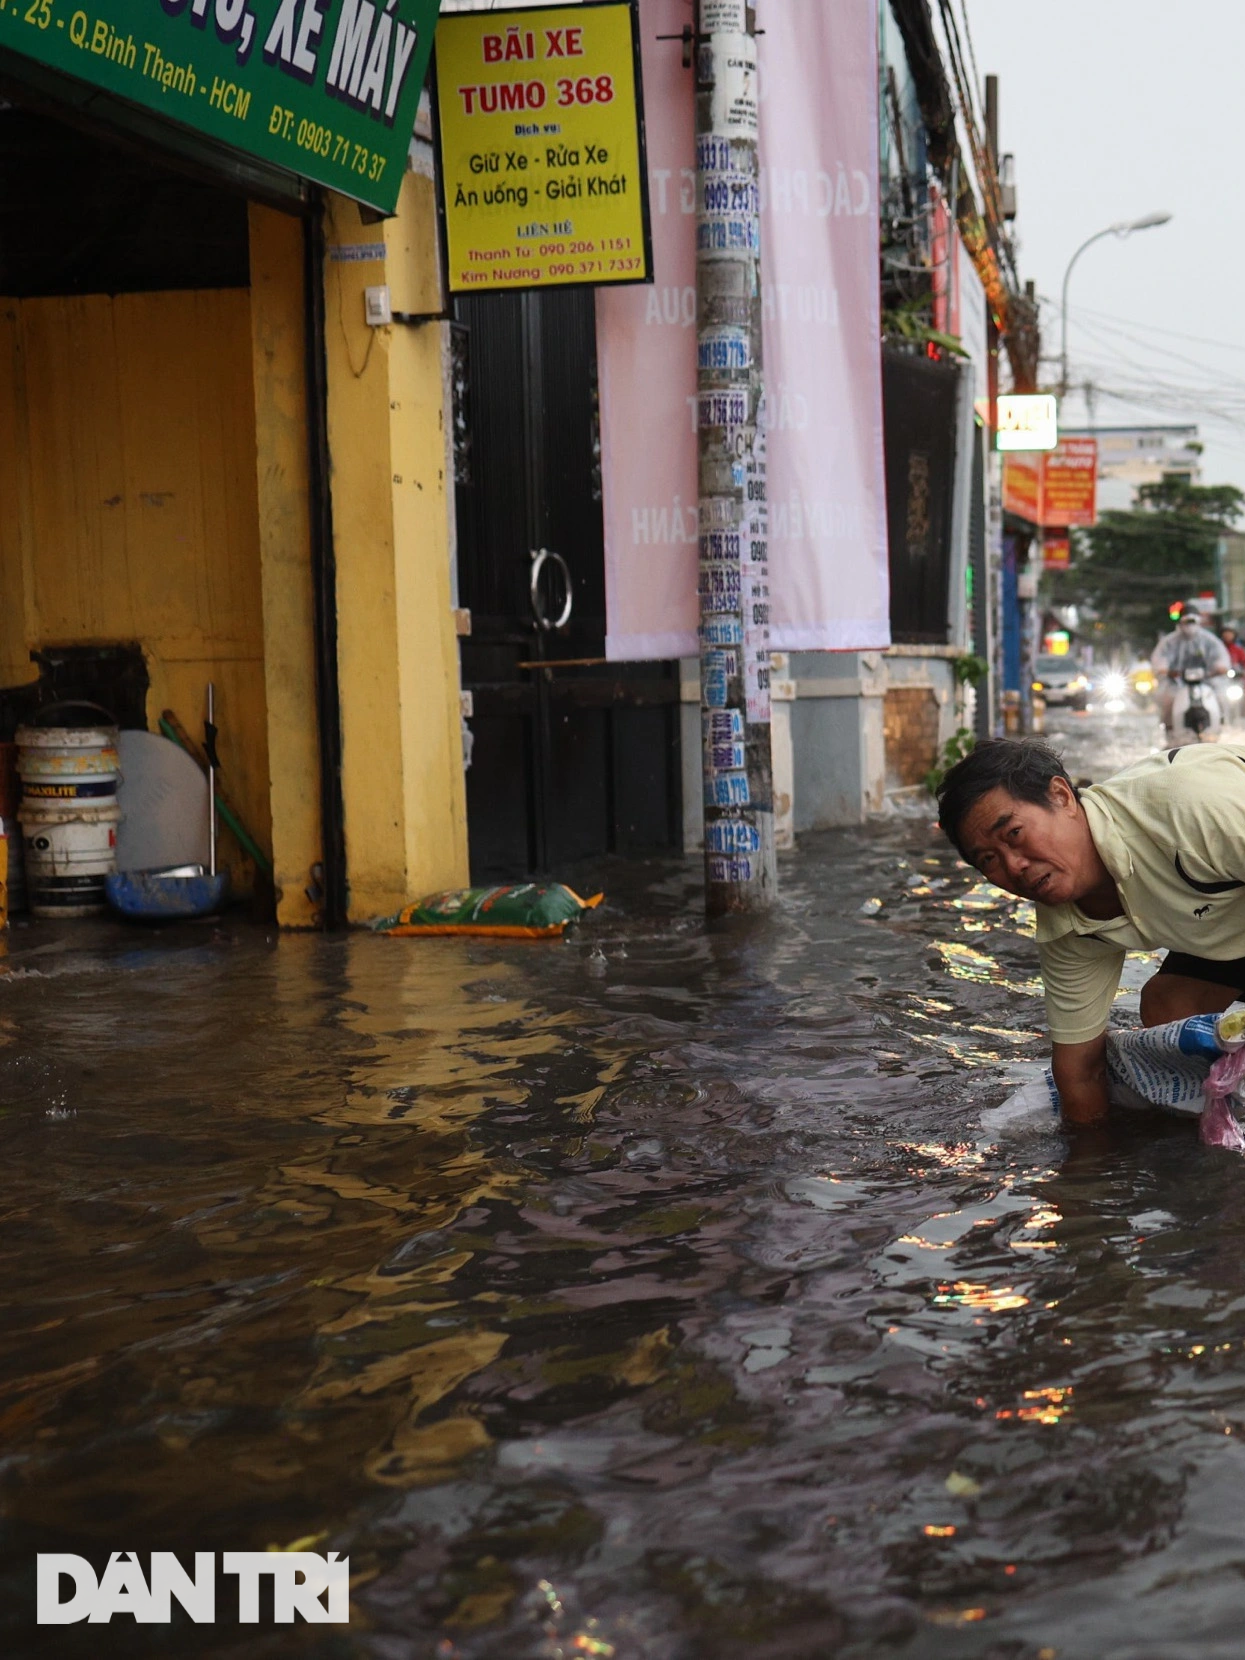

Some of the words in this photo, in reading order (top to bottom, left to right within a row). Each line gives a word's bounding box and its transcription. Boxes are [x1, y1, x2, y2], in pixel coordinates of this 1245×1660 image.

[327, 0, 417, 118] MÁY
[483, 26, 535, 63] BÃI
[546, 28, 584, 58] XE
[143, 42, 197, 97] Thạnh
[209, 76, 252, 120] HCM
[297, 118, 332, 157] 0903
[333, 135, 351, 165] 71
[352, 144, 369, 174] 73
[369, 155, 387, 182] 37
[459, 81, 546, 115] TUMO
[556, 75, 614, 107] 368
[470, 153, 500, 174] Giữ
[505, 152, 529, 171] Xe
[547, 145, 580, 168] Rửa
[585, 145, 609, 165] Xe
[454, 182, 478, 207] Ăn
[484, 181, 528, 208] uống
[546, 175, 582, 200] Giải
[588, 173, 627, 197] Khát
[468, 249, 511, 262] Thanh
[461, 271, 488, 283] Kim
